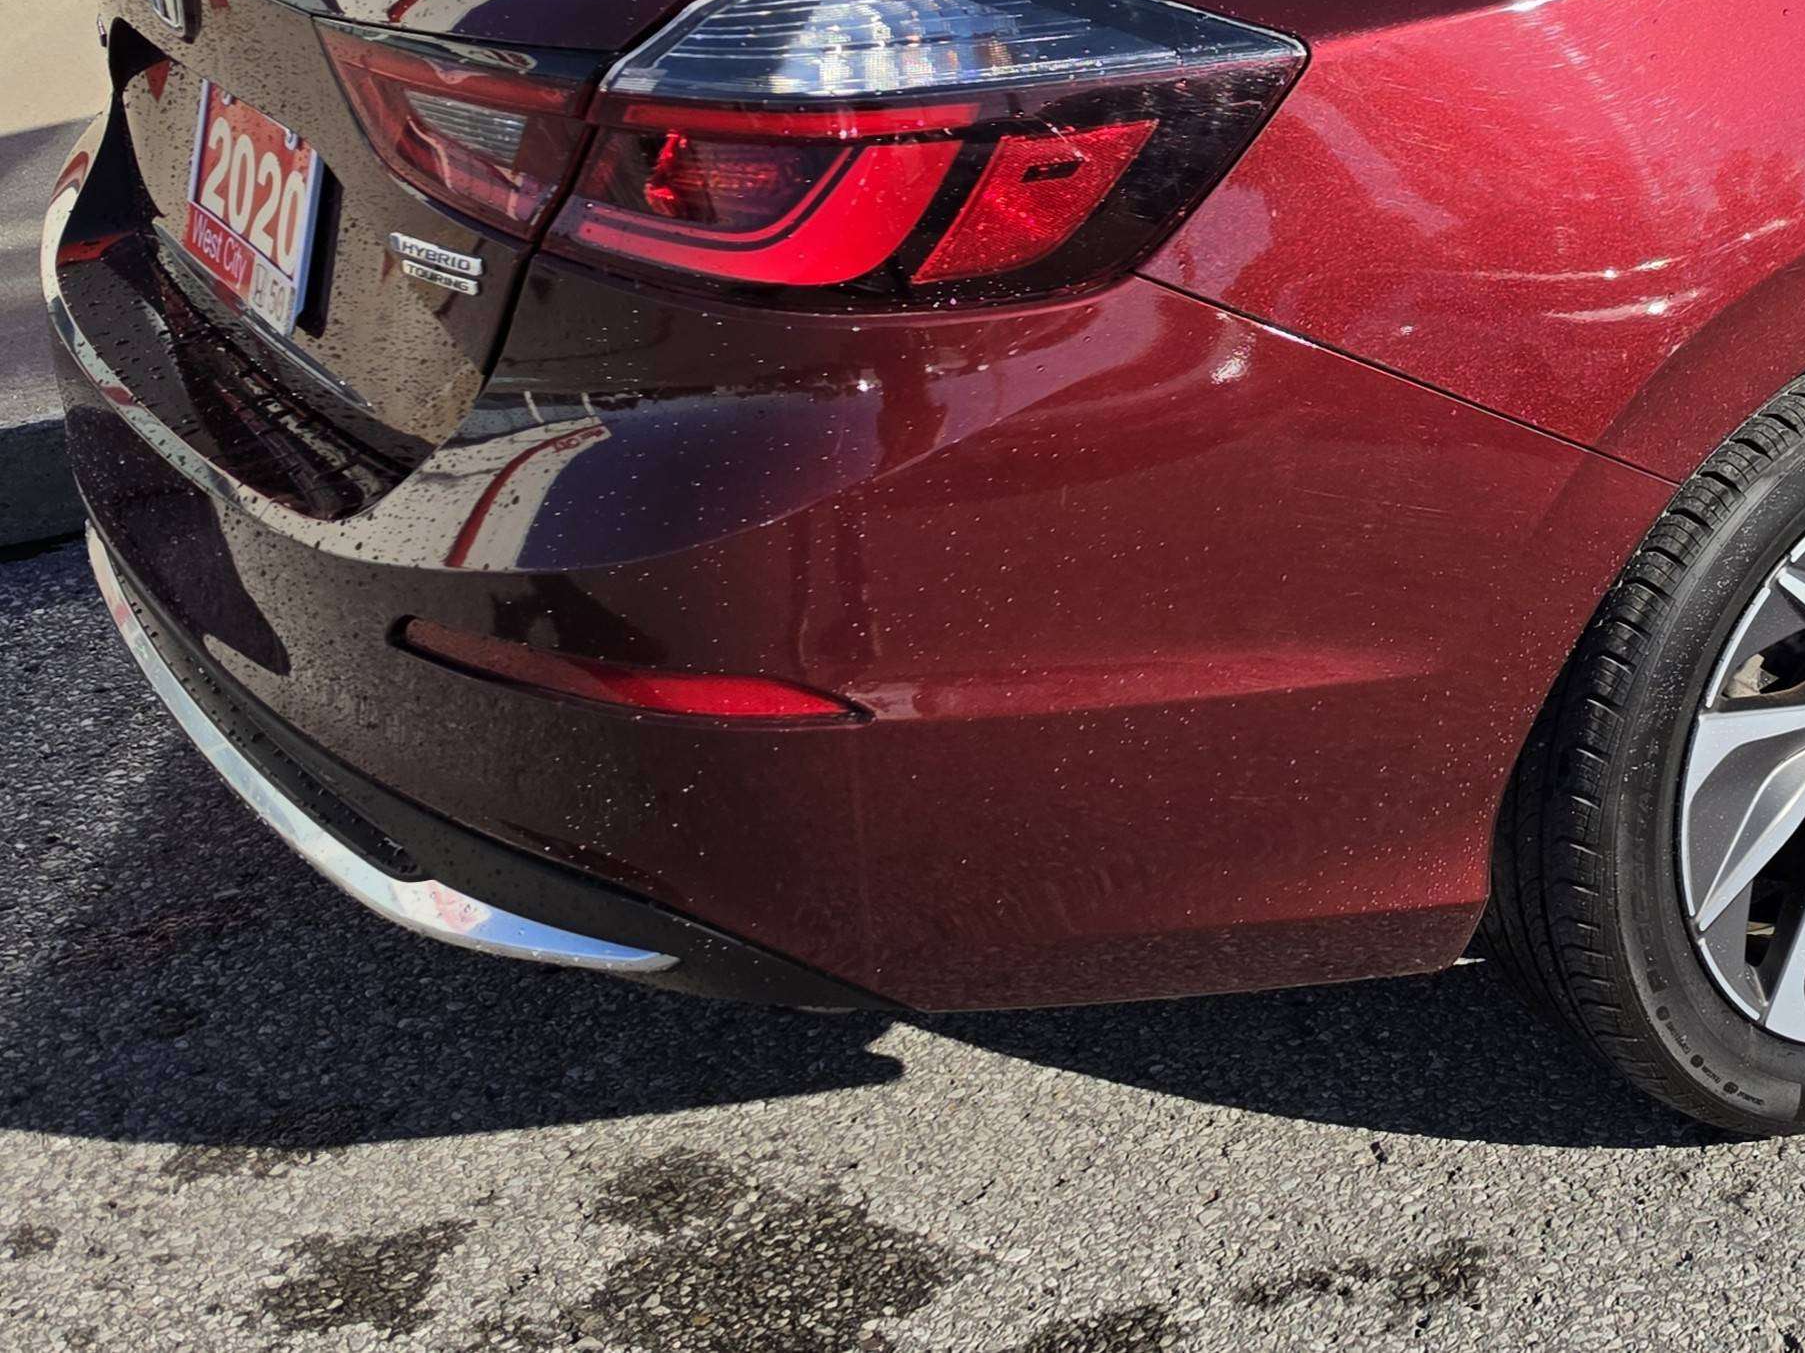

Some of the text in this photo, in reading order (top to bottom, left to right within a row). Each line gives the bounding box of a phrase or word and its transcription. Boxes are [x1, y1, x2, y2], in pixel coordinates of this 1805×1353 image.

[200, 115, 306, 274] 2020
[191, 209, 288, 323] West City 50
[402, 241, 471, 271] HYBRID
[407, 263, 469, 291] TOURING
